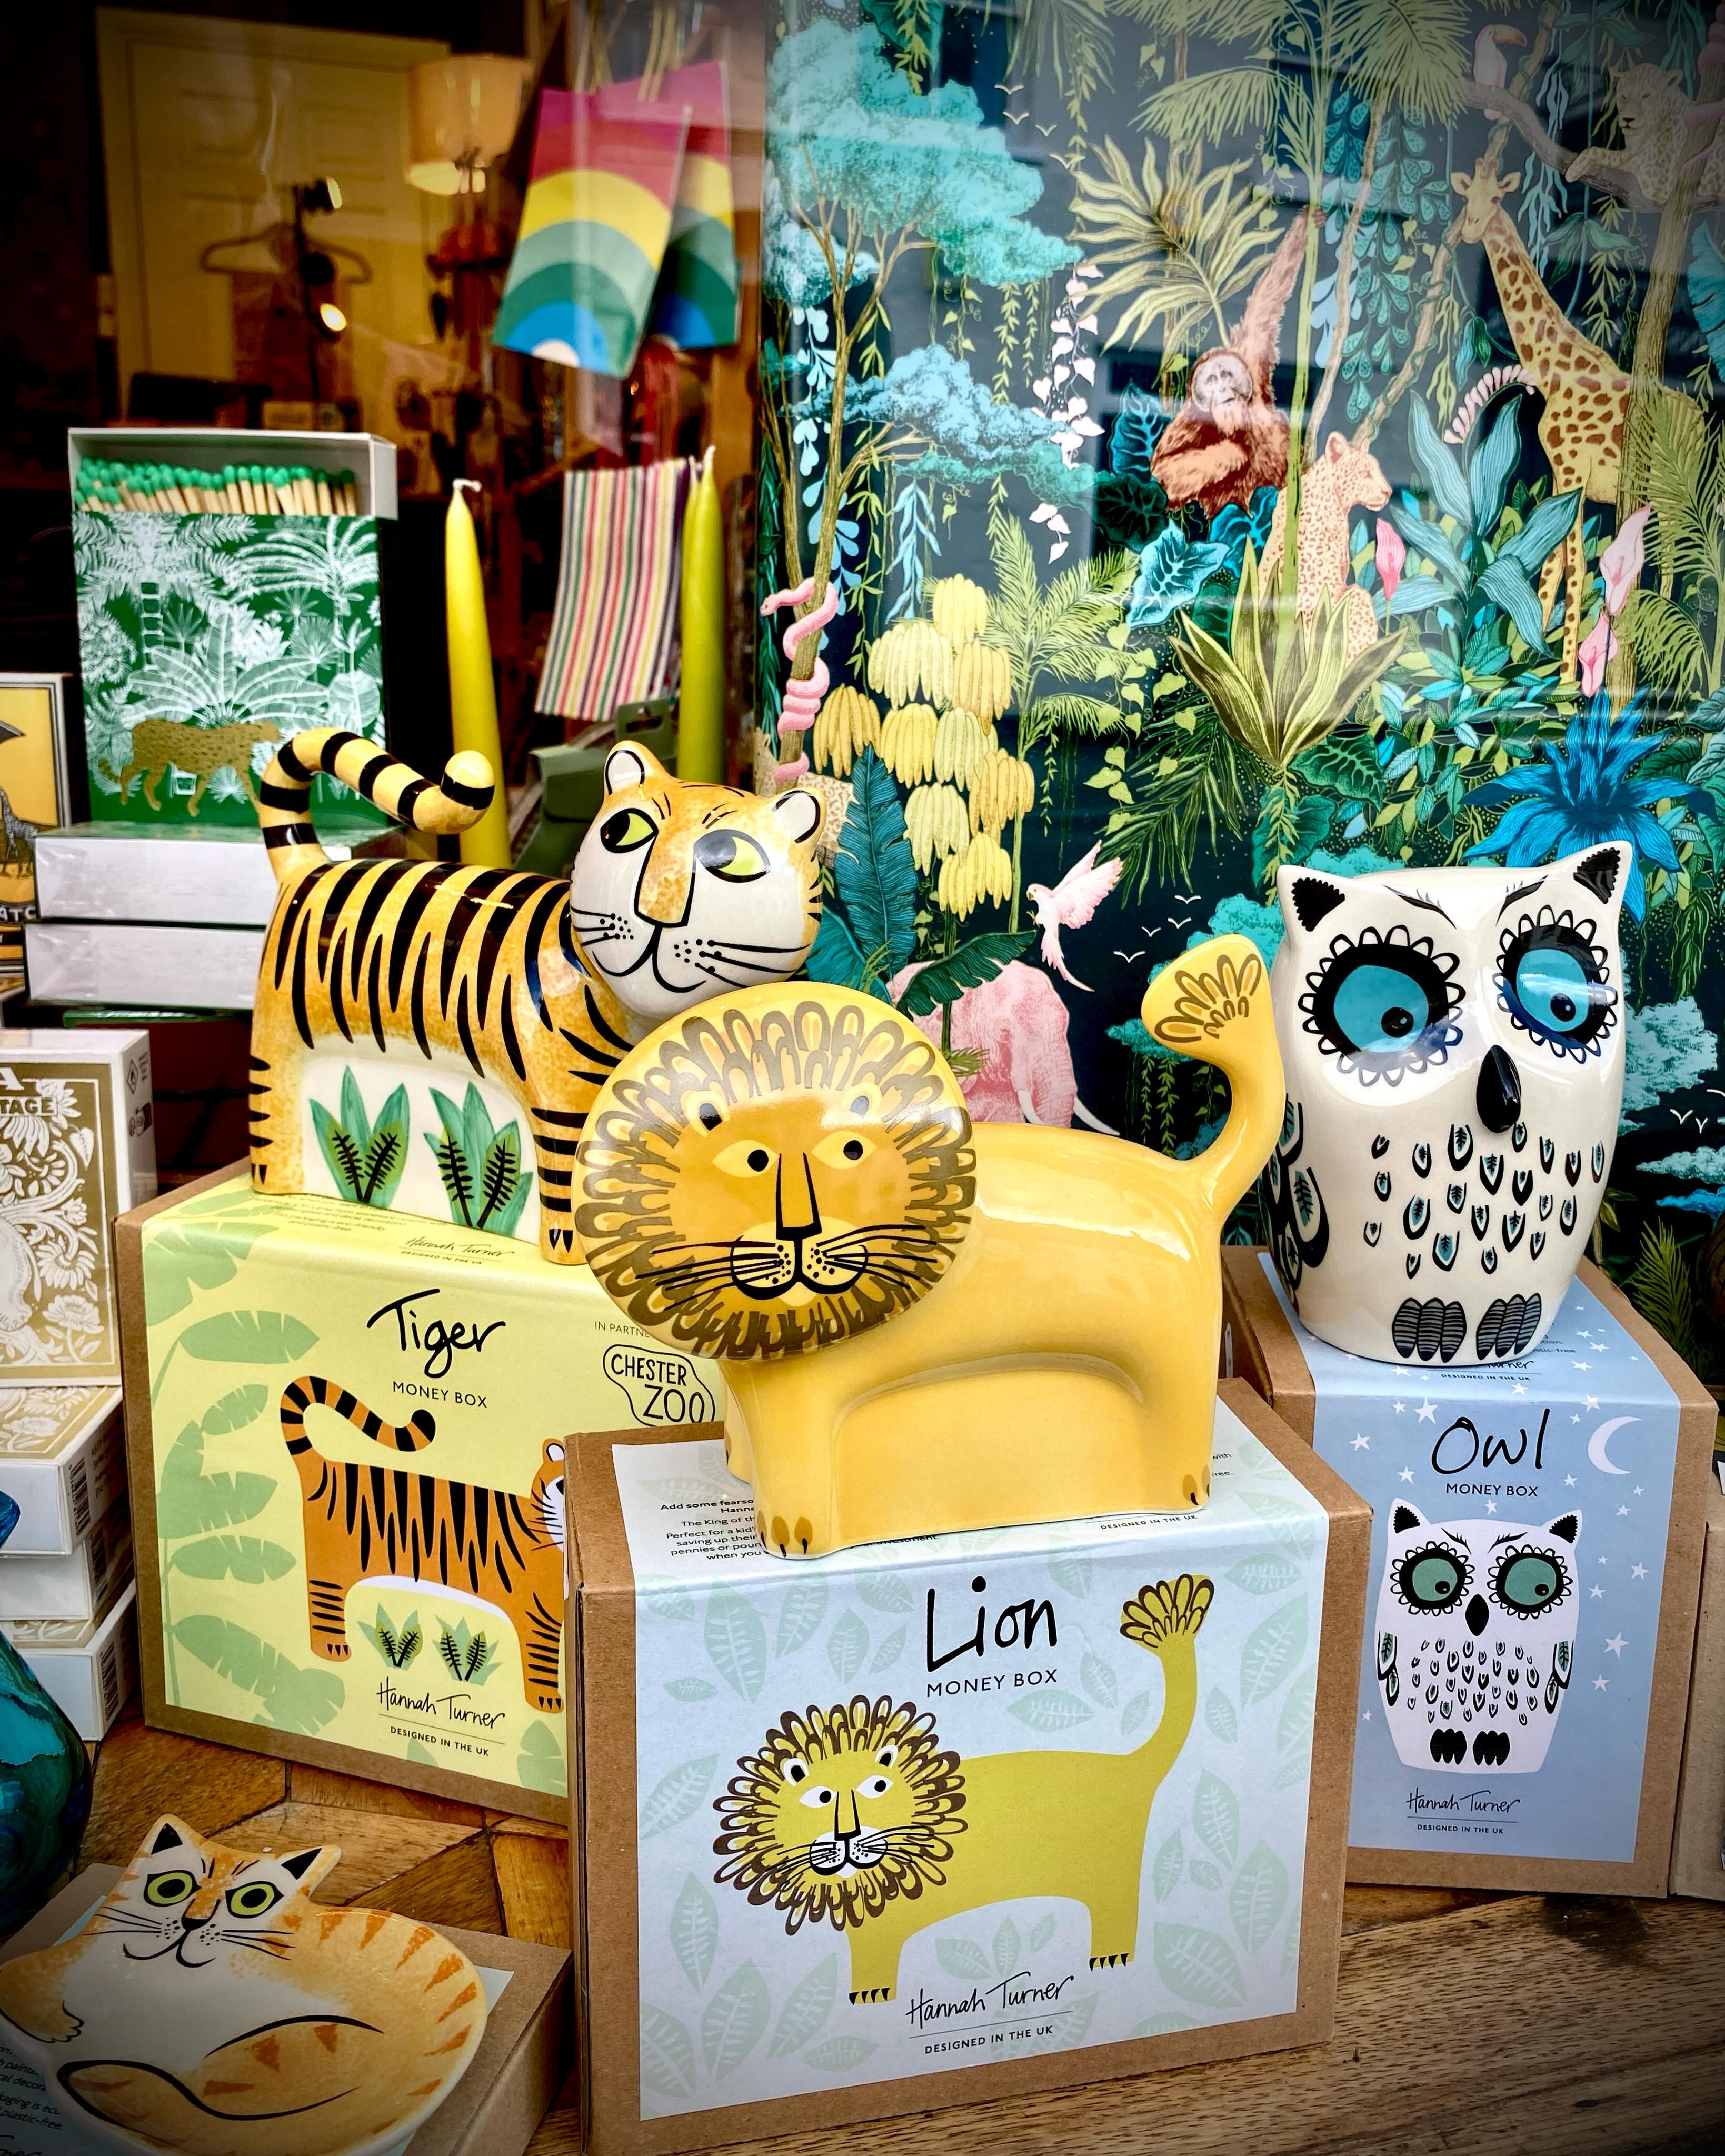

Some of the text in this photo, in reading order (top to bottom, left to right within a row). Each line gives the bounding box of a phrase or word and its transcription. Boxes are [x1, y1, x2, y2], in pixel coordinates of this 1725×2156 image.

[405, 1236, 515, 1257] Hannah Turner
[367, 1288, 506, 1379] Tiger
[595, 1321, 606, 1331] IN
[611, 1353, 687, 1386] CHESTER
[393, 1381, 487, 1409] MONEY BOX
[643, 1384, 704, 1423] ZOO
[1431, 1408, 1550, 1474] Owl
[1446, 1483, 1538, 1497] MONEY BOX
[1100, 1521, 1147, 1530] DESIGNED
[671, 1547, 715, 1556] pennies
[927, 1576, 1058, 1672] Lion
[927, 1669, 1058, 1698] MONEY BOX
[376, 1676, 505, 1729] Hannah Turner
[391, 1726, 489, 1756] DESIGNED IN THE UK
[1406, 1787, 1520, 1814] Hannah Turner
[905, 1971, 1074, 2029] Hannah Turner
[925, 2025, 1053, 2054] DESIGNED IN THE UK
[3, 2062, 39, 2077] painte
[13, 2077, 46, 2091] decora
